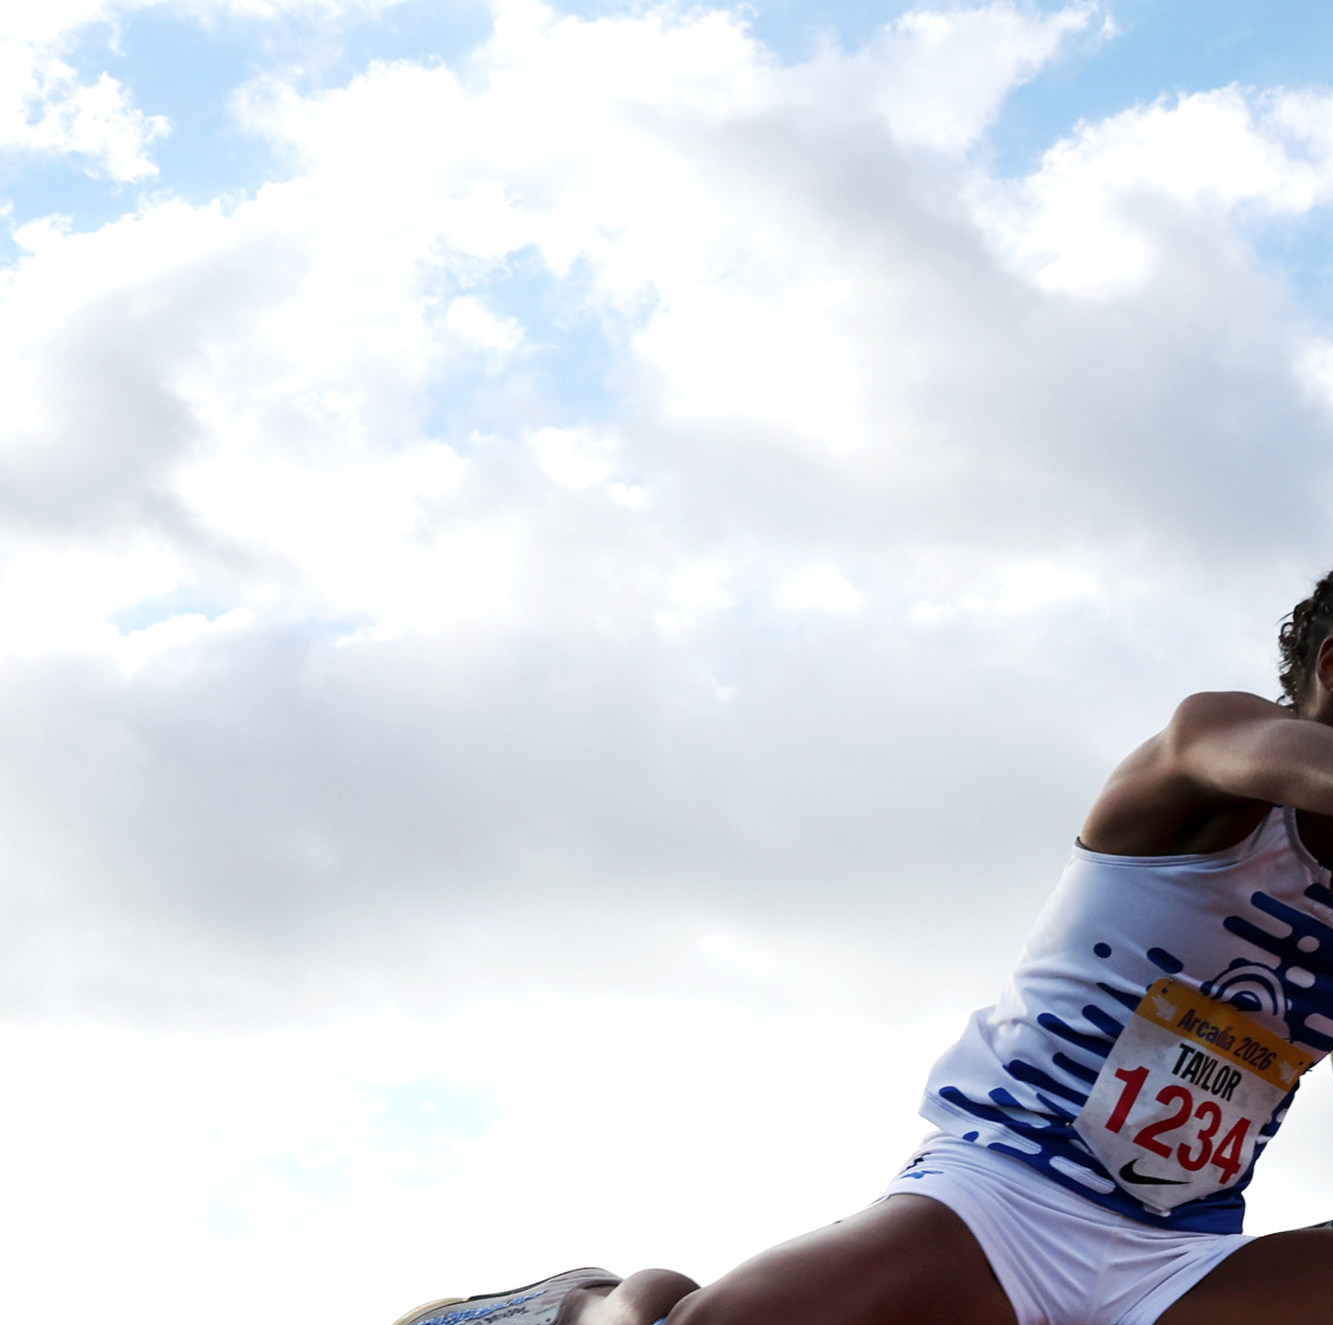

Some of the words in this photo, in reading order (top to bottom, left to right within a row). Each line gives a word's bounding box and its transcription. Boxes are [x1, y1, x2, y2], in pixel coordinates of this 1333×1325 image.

[1177, 1008, 1236, 1051] Arcadia
[1233, 1037, 1278, 1071] 2026
[1171, 1043, 1242, 1102] TAYLOR
[1105, 1065, 1251, 1185] 1234
